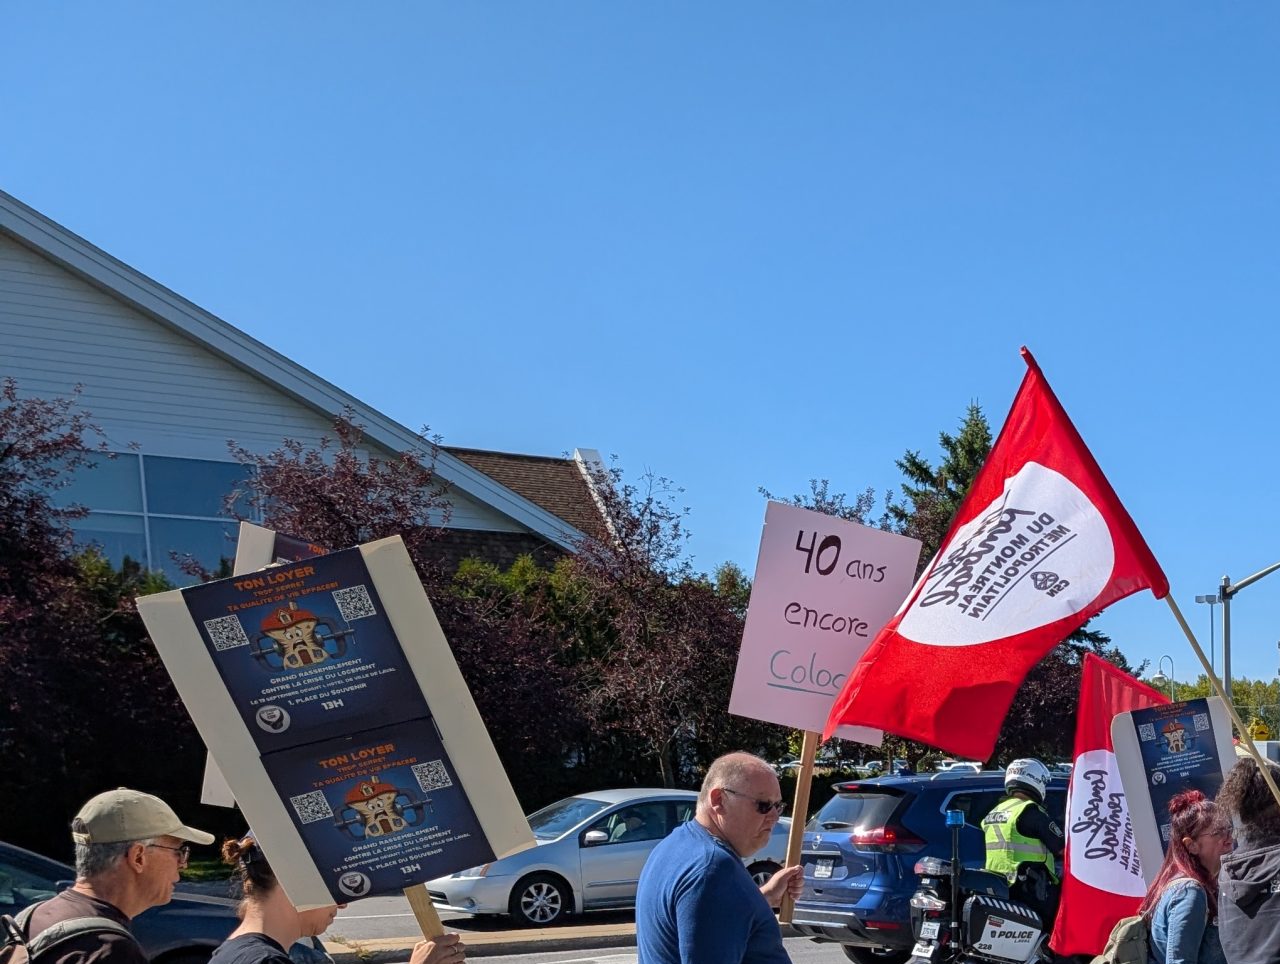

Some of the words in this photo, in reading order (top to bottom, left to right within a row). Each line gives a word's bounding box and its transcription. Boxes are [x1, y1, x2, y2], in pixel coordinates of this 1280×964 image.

[796, 530, 842, 576] 40
[845, 560, 887, 582] ans
[234, 579, 265, 591] TON
[267, 566, 315, 584] LOYER
[784, 602, 868, 637] encore
[270, 673, 297, 684] GRAND
[299, 658, 362, 677] RASSEMBLEMENT
[261, 684, 290, 695] CONTRE
[302, 675, 324, 685] CRISE
[296, 694, 318, 704] PLACE
[319, 691, 330, 699] DU
[321, 699, 344, 710] 13H
[319, 755, 348, 768] TON
[351, 743, 396, 761] LOYER
[352, 842, 378, 853] GRAND
[379, 826, 439, 846] RASSEMBLEMENT
[403, 840, 414, 848] DU
[376, 860, 397, 870] PLACE
[400, 863, 421, 874] 13H
[998, 931, 1034, 939] POLICE
